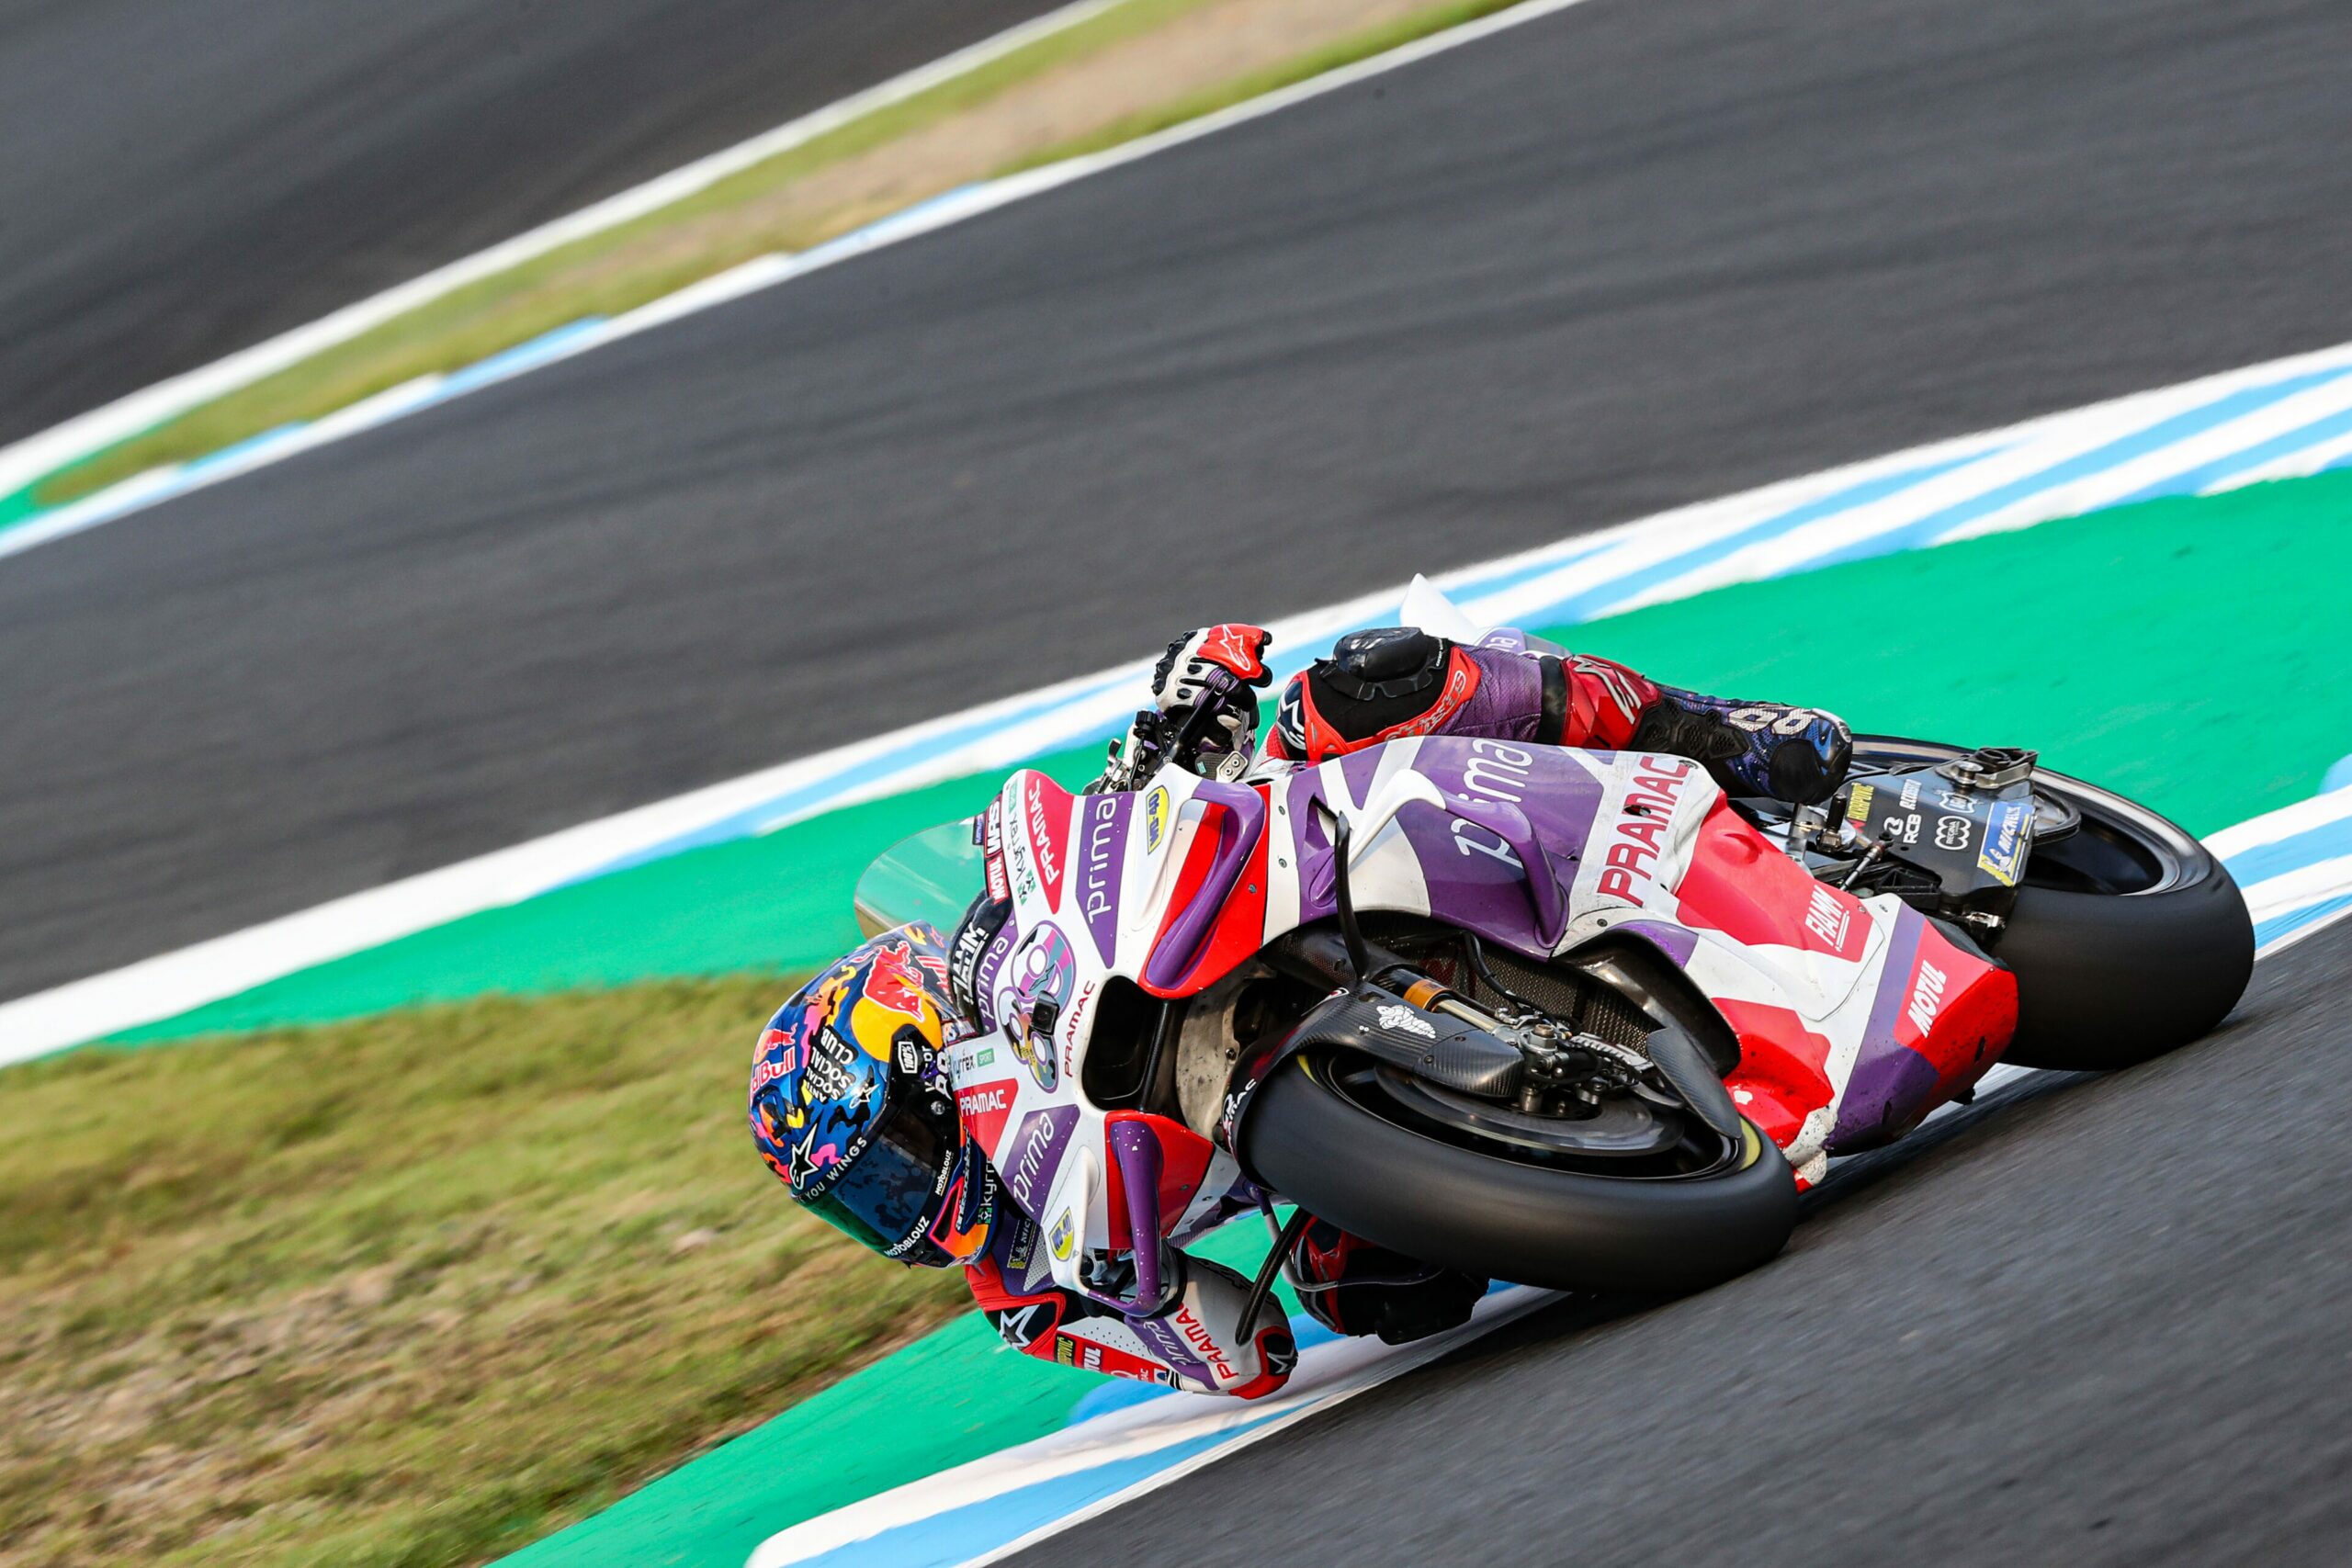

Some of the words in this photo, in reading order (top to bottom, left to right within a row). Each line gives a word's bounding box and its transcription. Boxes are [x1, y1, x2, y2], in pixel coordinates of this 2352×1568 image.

[1451, 739, 1533, 870] pima
[1597, 755, 1691, 908] PRAMAC
[1904, 814, 1922, 844] RCB
[1028, 778, 1059, 886] PRAMAC
[989, 856, 1006, 900] MOTUL
[1087, 796, 1118, 925] prima
[1805, 884, 1839, 946] FIAMM
[979, 936, 1009, 1021] prima
[1906, 960, 1948, 1036] MOTUL
[998, 919, 1076, 1093] 89
[1064, 980, 1095, 1077] PRAMAC
[760, 1045, 797, 1088] Bull
[811, 1046, 854, 1089] SOCIAL
[820, 1027, 854, 1065] CLUB
[901, 1043, 912, 1070] 100%
[806, 1066, 842, 1101] SOCIAL
[959, 1089, 1007, 1118] PRAMAC
[805, 1181, 826, 1201] YOU
[826, 1136, 867, 1182] WINGS
[934, 1150, 952, 1196] MOTOBLOUZ
[1013, 1111, 1054, 1213] prima
[884, 1215, 930, 1258] MOTOBLOUZ
[1084, 1348, 1101, 1371] TUL
